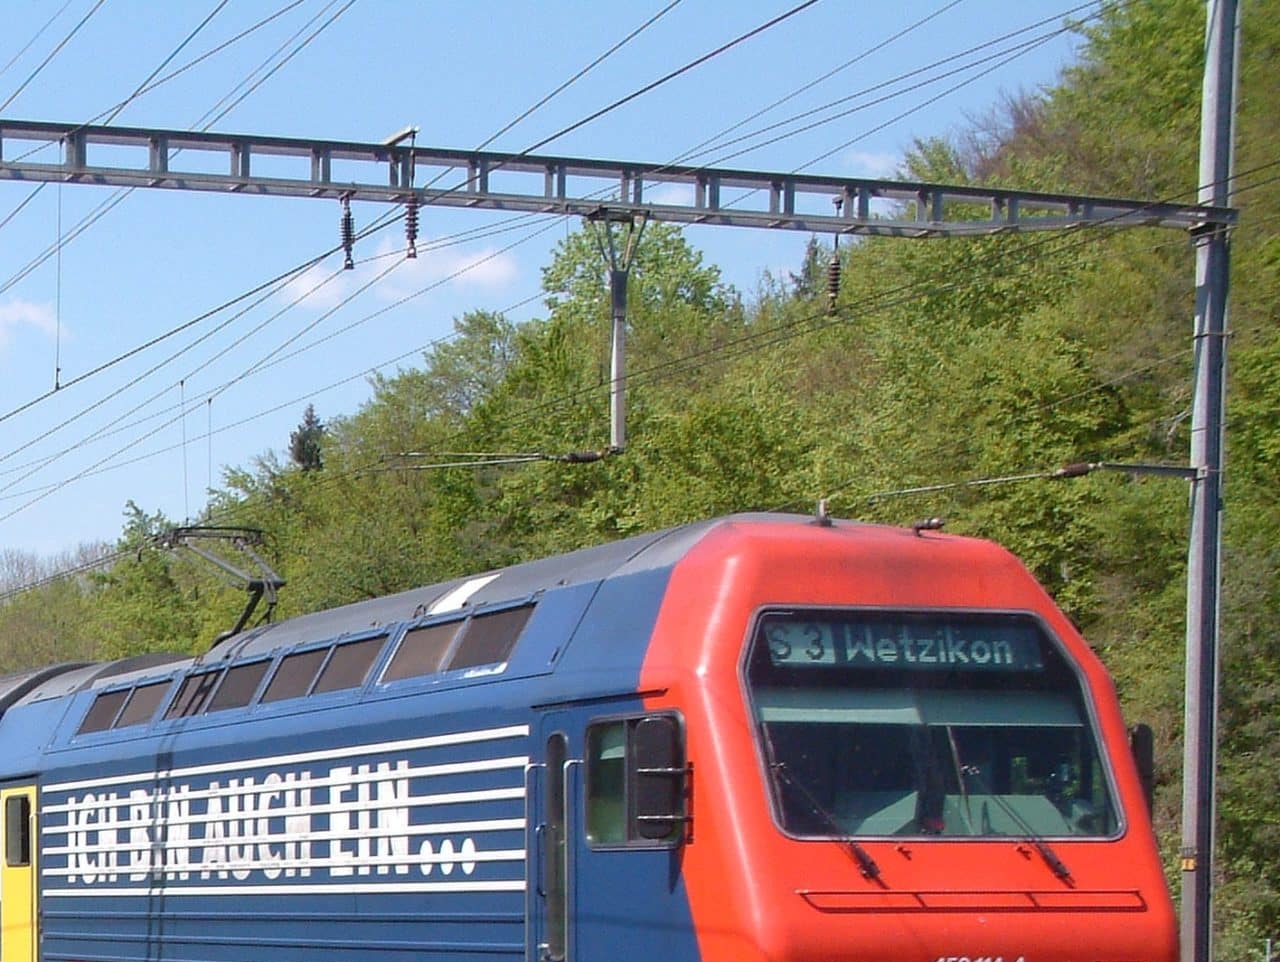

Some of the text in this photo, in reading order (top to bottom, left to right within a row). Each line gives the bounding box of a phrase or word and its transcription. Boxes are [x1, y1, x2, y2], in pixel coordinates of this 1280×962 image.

[804, 625, 826, 660] 3
[845, 624, 1013, 664] Wetzikon
[67, 793, 117, 884] ICH
[129, 784, 190, 882] BIN
[200, 771, 312, 881] AUCH
